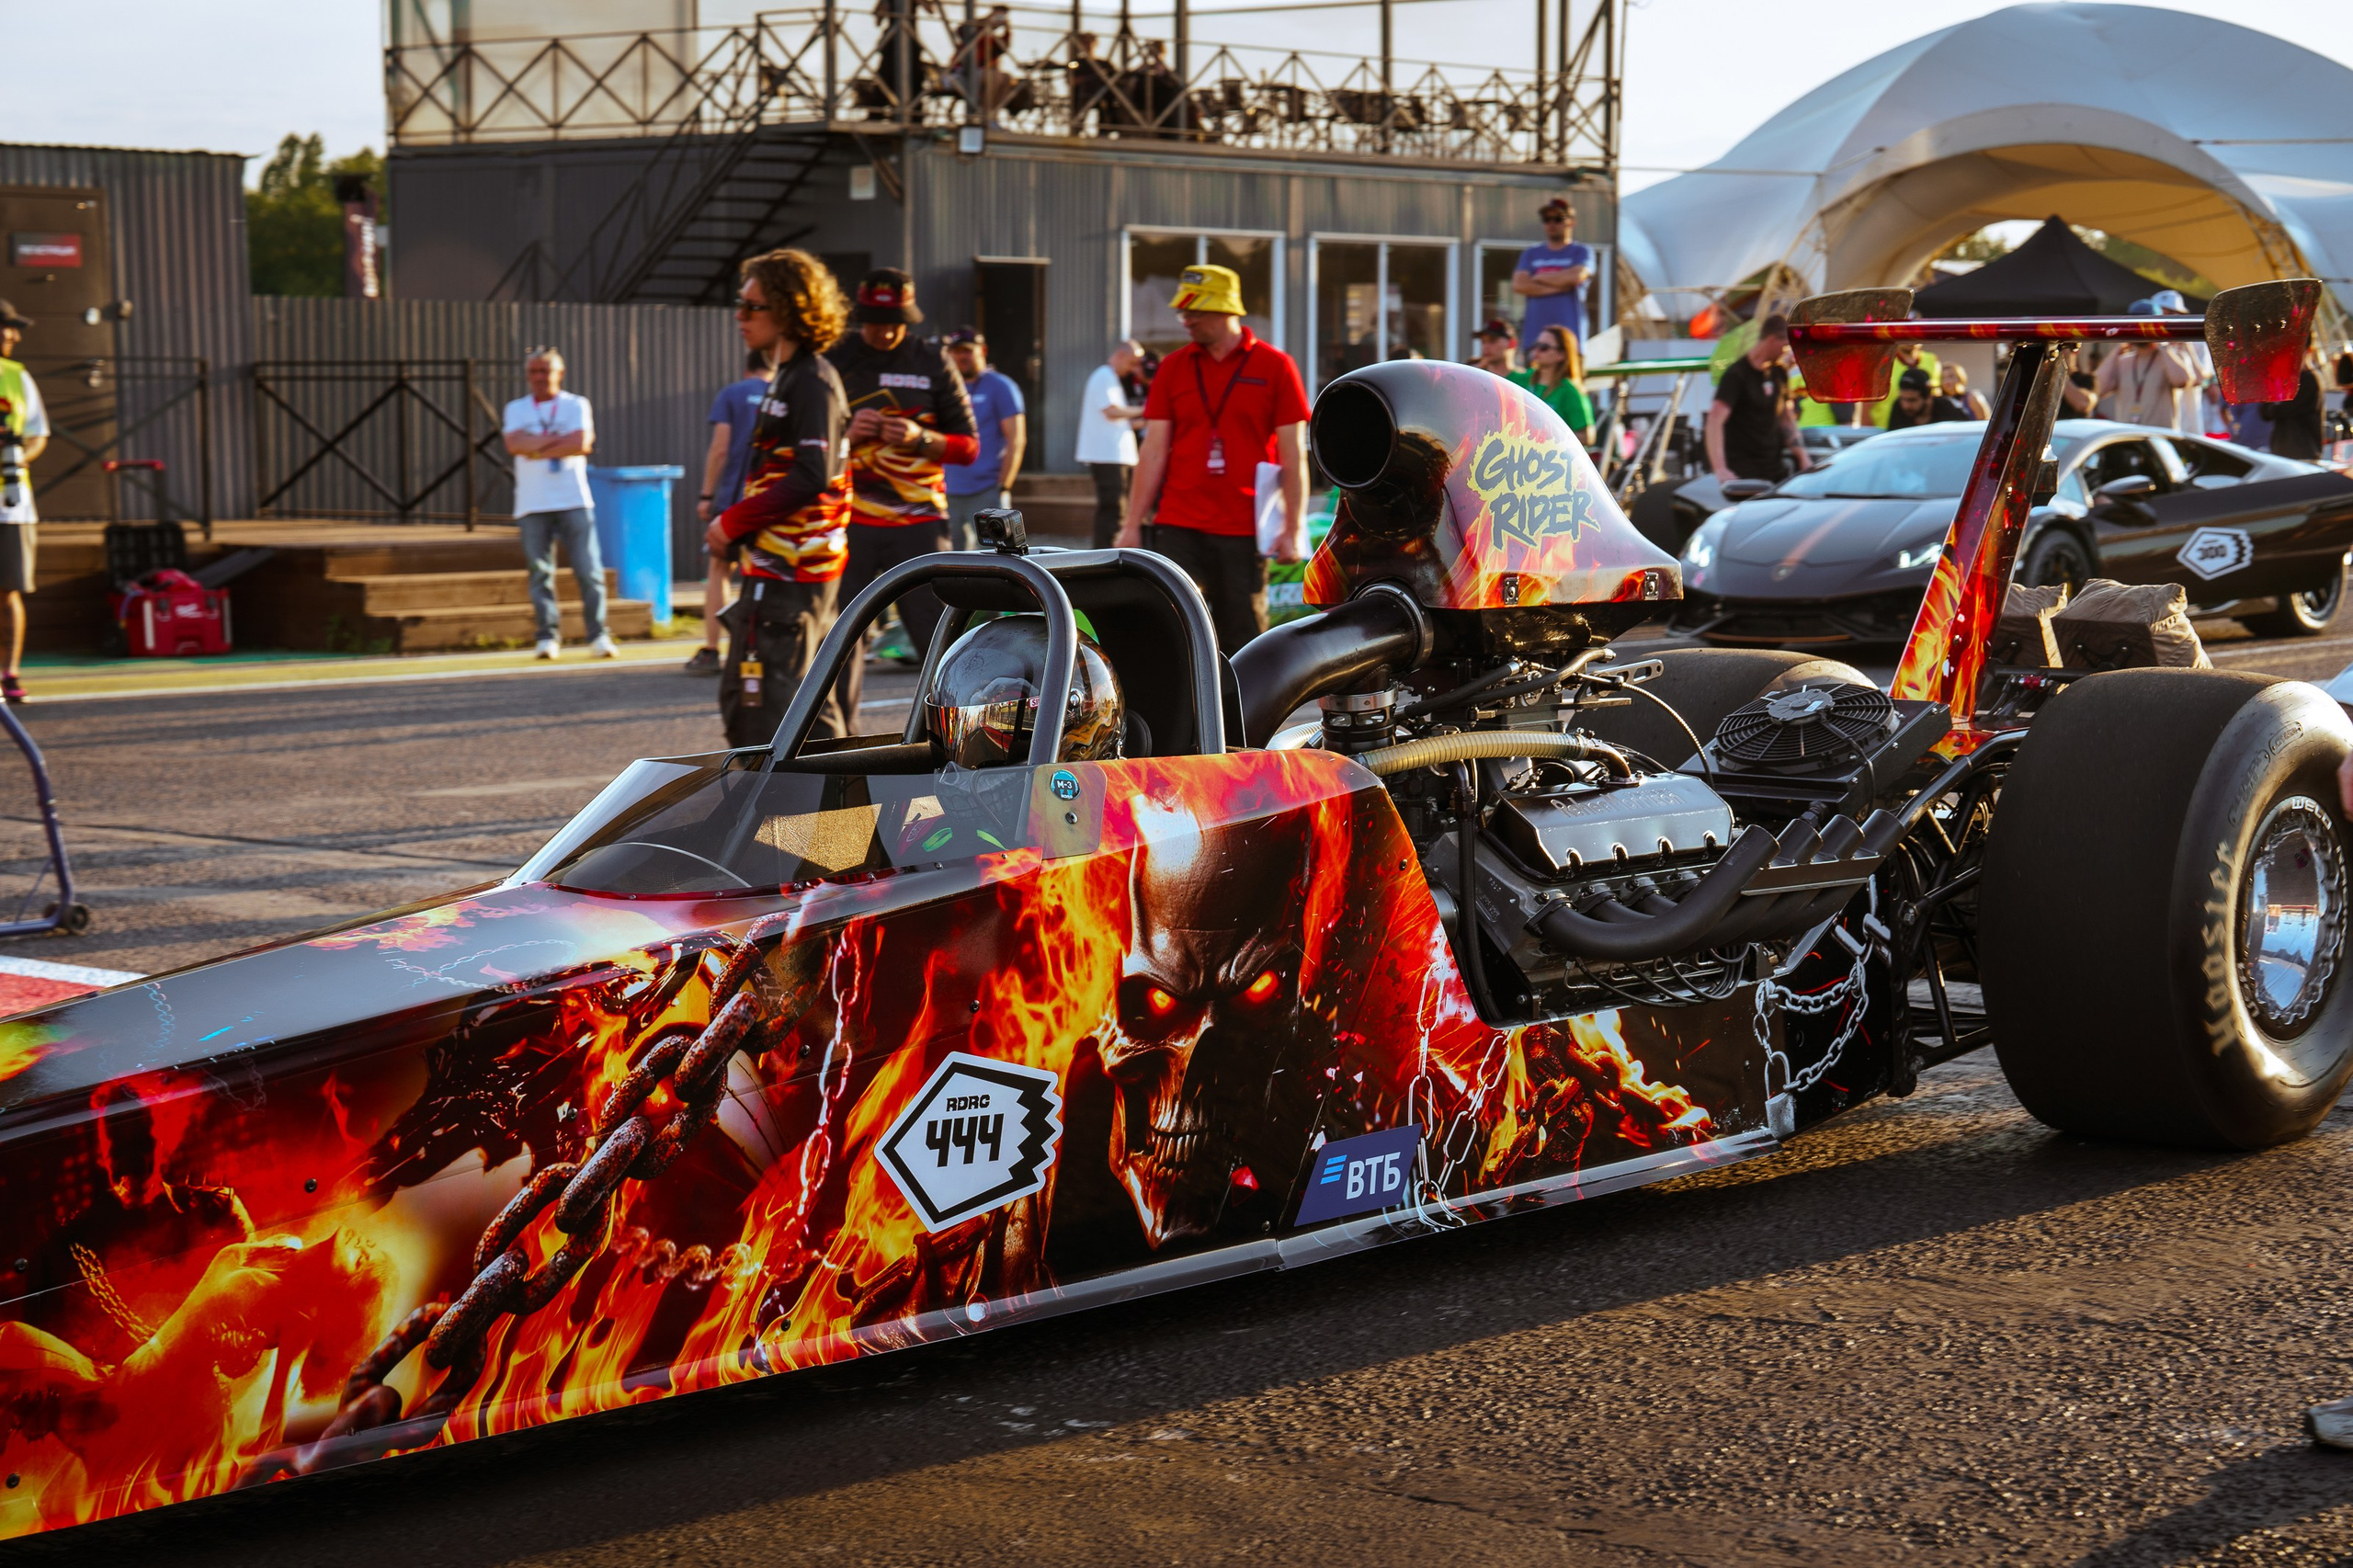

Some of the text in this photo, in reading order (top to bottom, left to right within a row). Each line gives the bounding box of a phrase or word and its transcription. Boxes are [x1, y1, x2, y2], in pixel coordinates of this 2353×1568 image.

[1475, 437, 1575, 492] GHOST
[1489, 491, 1600, 551] RIDER
[1057, 780, 1073, 789] M-3
[2291, 797, 2333, 830] WELD
[946, 1094, 991, 1112] RDRC
[926, 1113, 1005, 1167] 444
[1346, 1152, 1401, 1199] ВТБ
